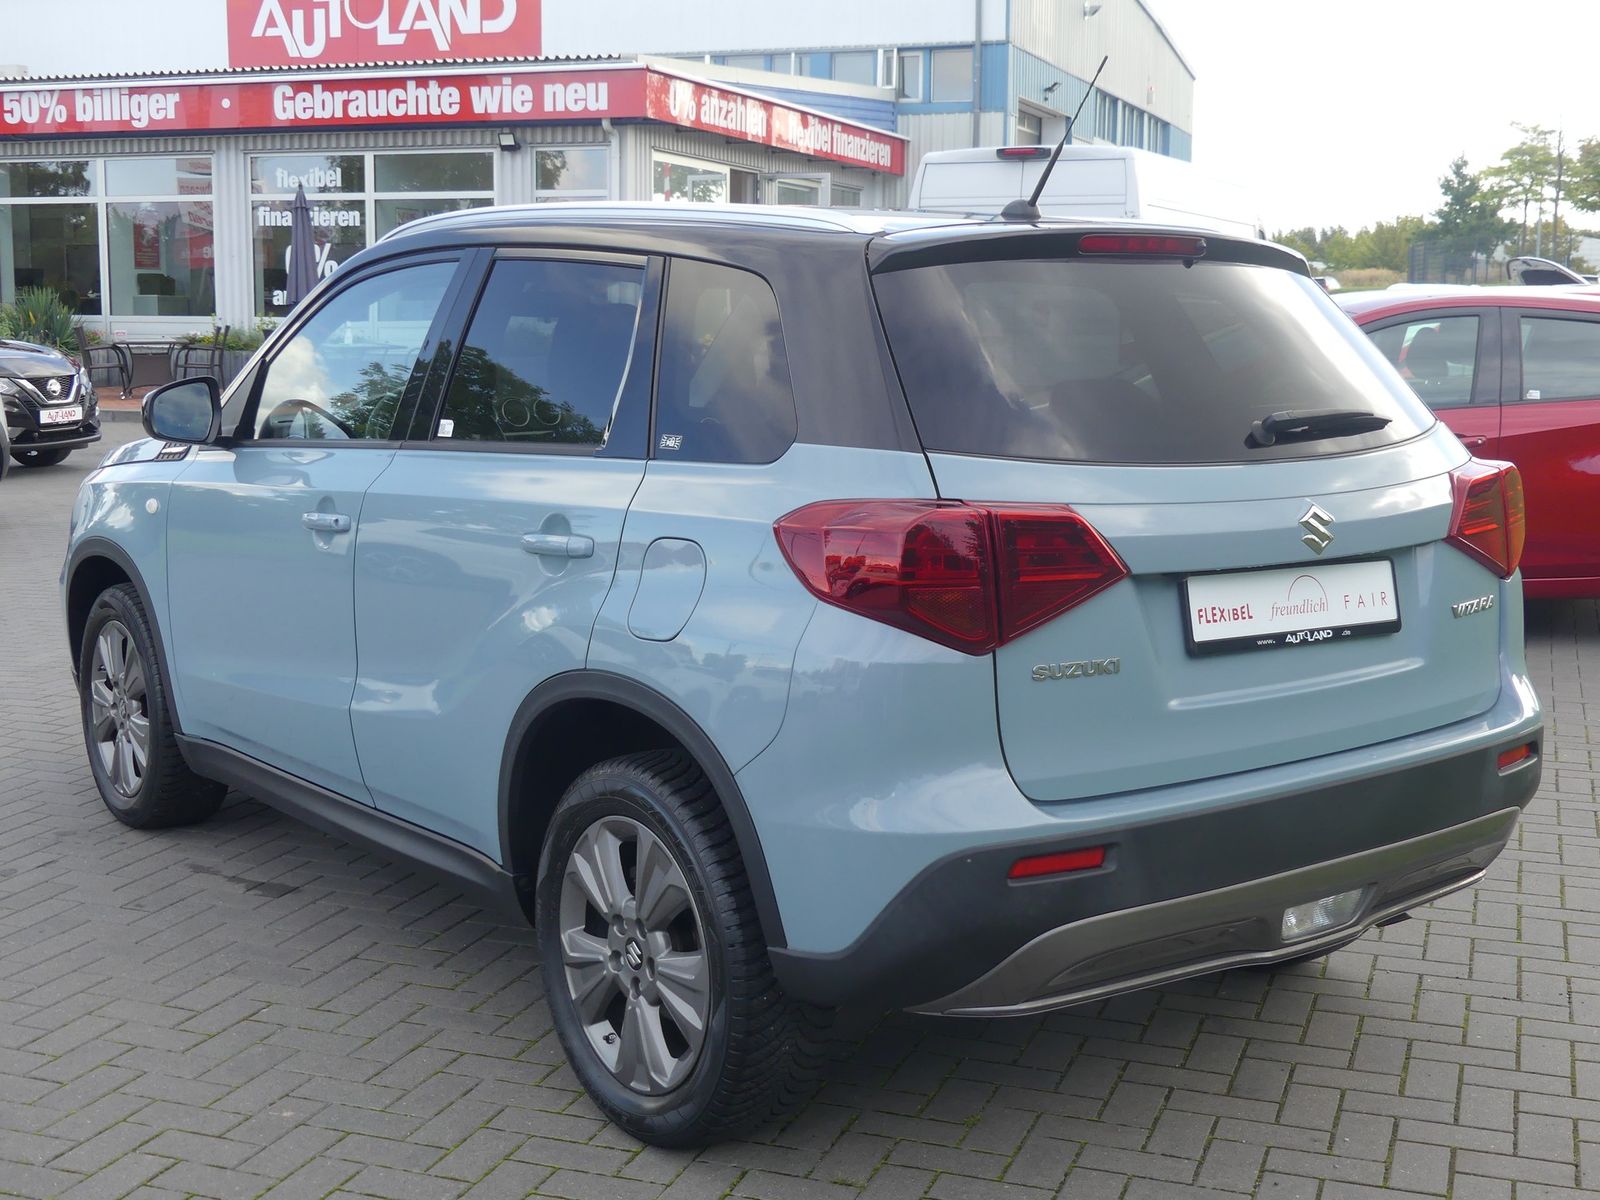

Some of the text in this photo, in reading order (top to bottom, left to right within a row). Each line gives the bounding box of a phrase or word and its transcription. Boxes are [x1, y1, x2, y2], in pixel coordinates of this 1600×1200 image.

[3, 87, 180, 128] 50% billiger
[273, 77, 609, 120] Gebrauchte wie neu
[669, 80, 696, 121] 0%
[701, 93, 767, 137] anzahlen
[832, 127, 891, 167] finanzieren
[276, 167, 342, 188] flexibel
[258, 206, 361, 227] finaieren
[1198, 591, 1388, 625] FLEXIBEL freundlich FAIR
[1032, 657, 1121, 681] SUZUKI
